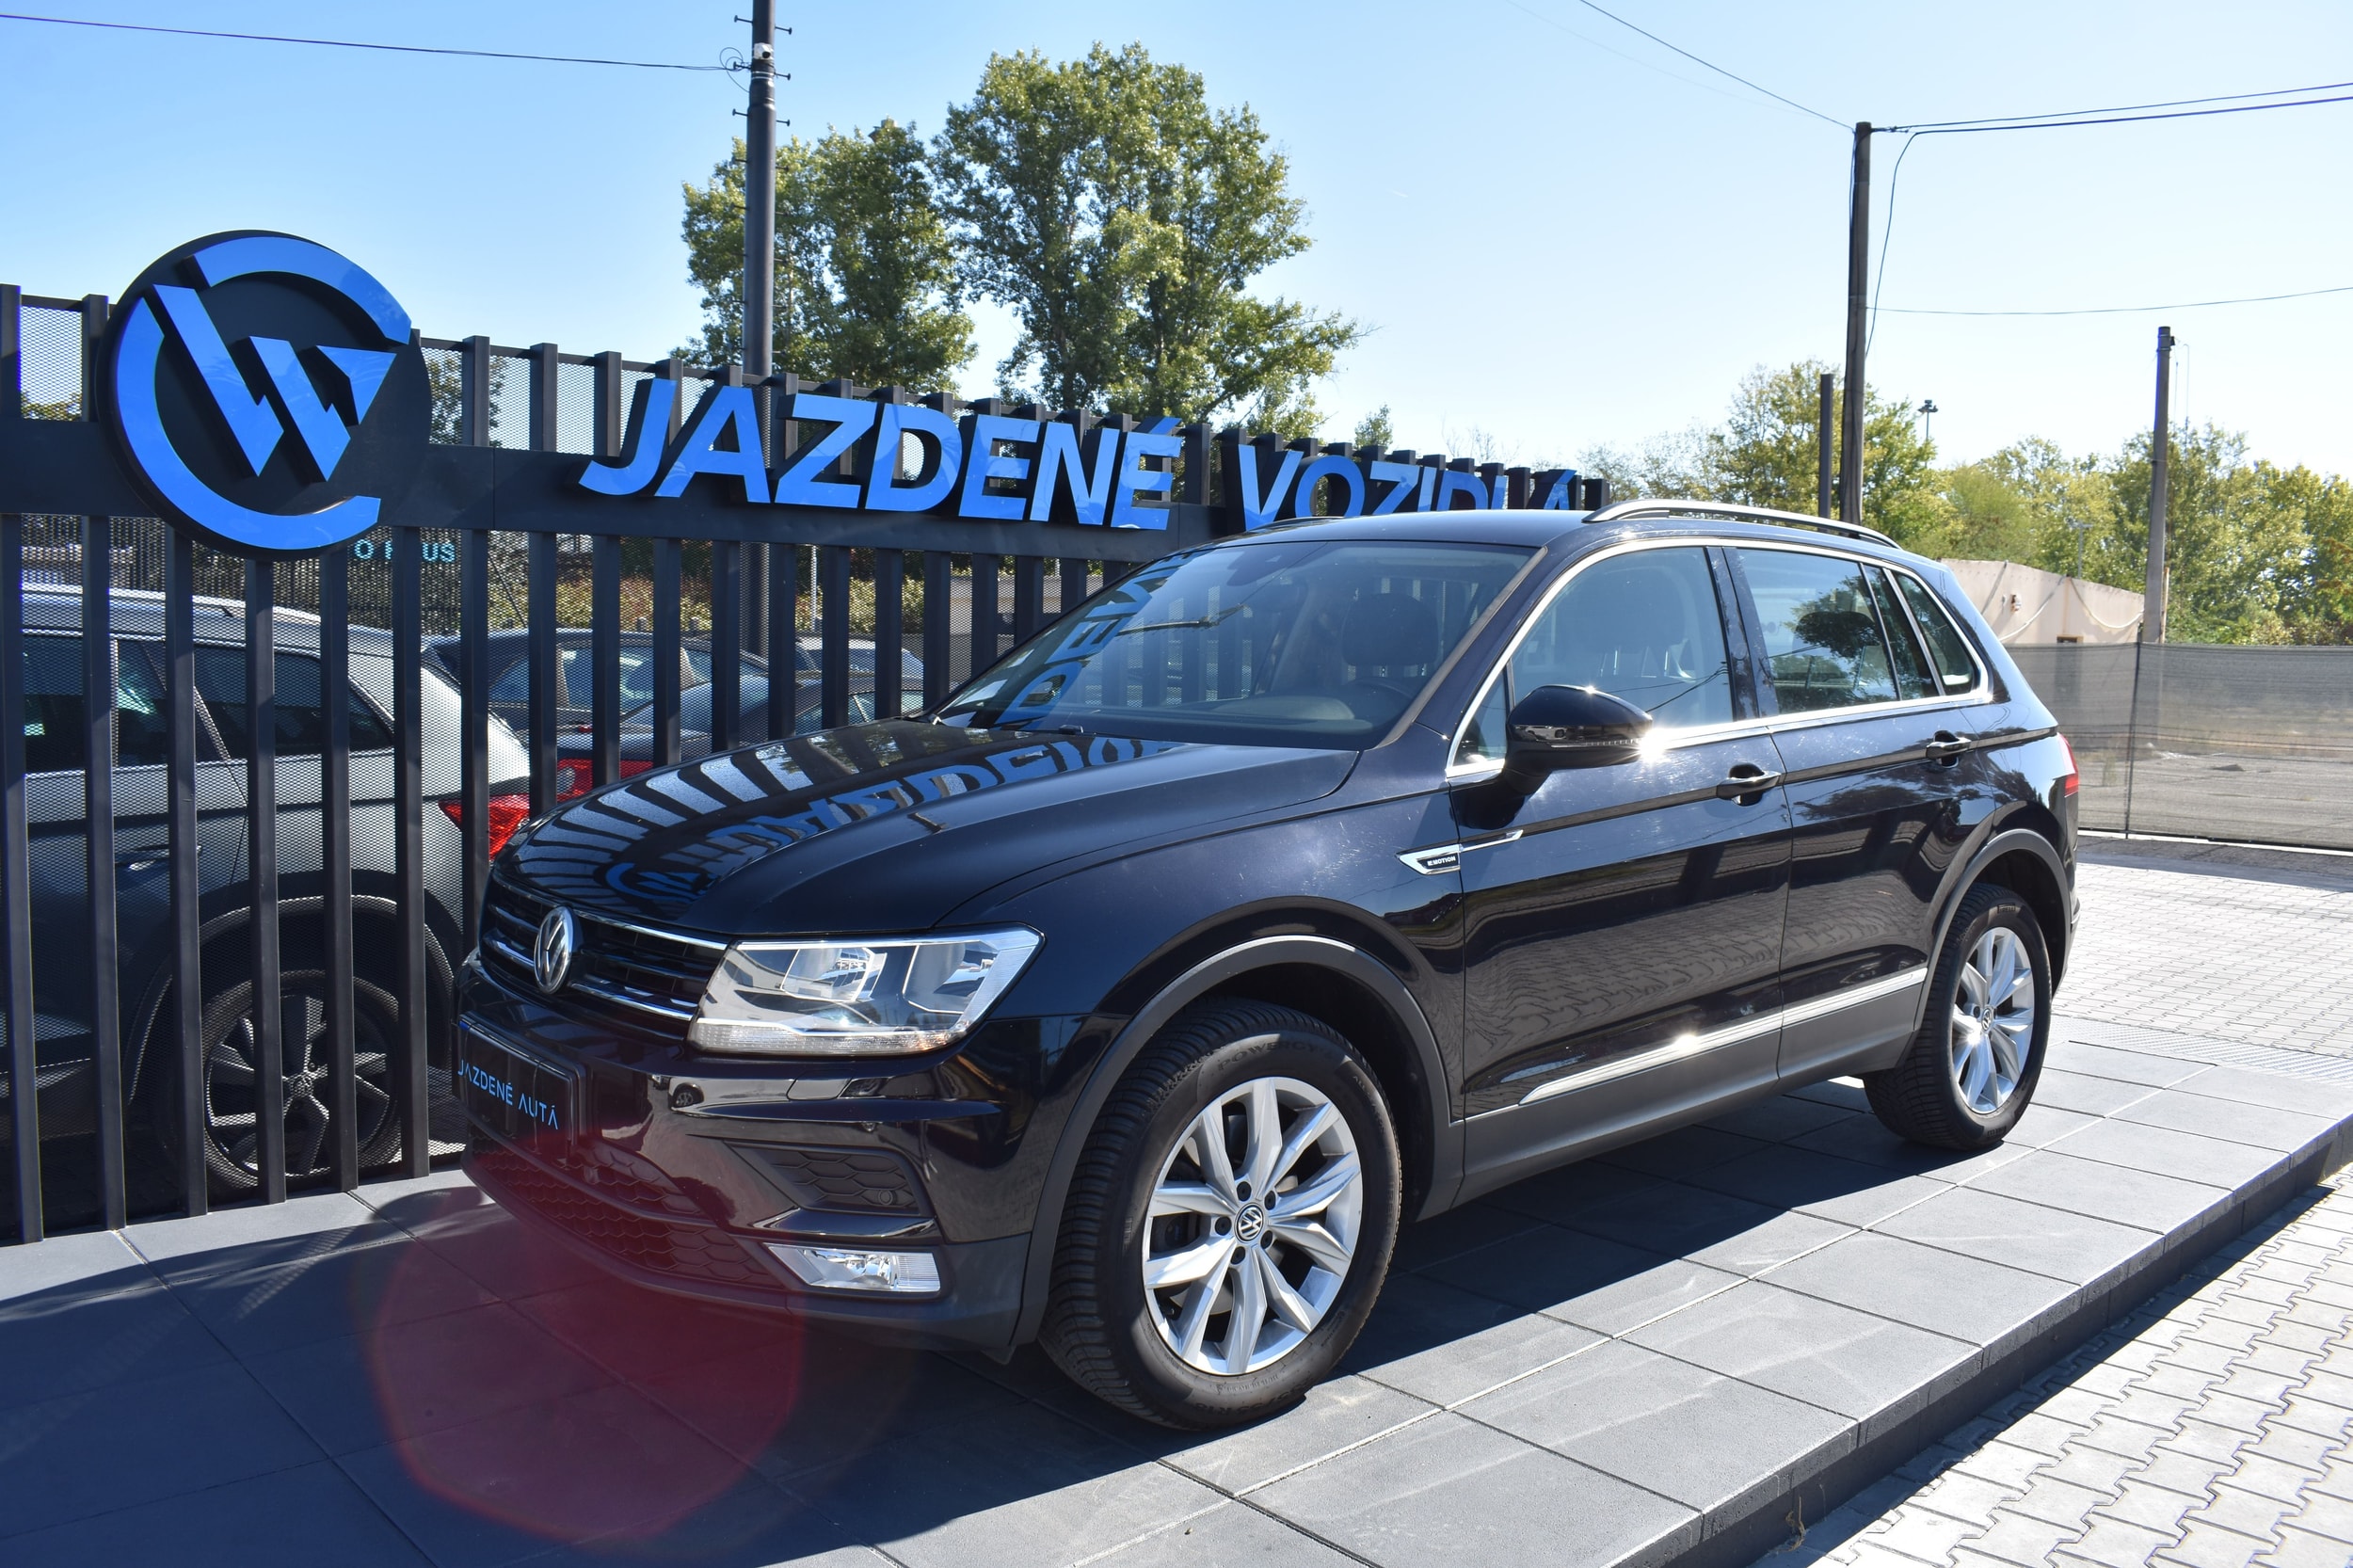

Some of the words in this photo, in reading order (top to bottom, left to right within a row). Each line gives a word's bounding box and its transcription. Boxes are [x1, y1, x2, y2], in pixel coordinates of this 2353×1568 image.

[578, 378, 1182, 531] JAZDENÉ
[457, 1059, 513, 1106] JAZDENÉ
[518, 1093, 559, 1130] AUTÁ
